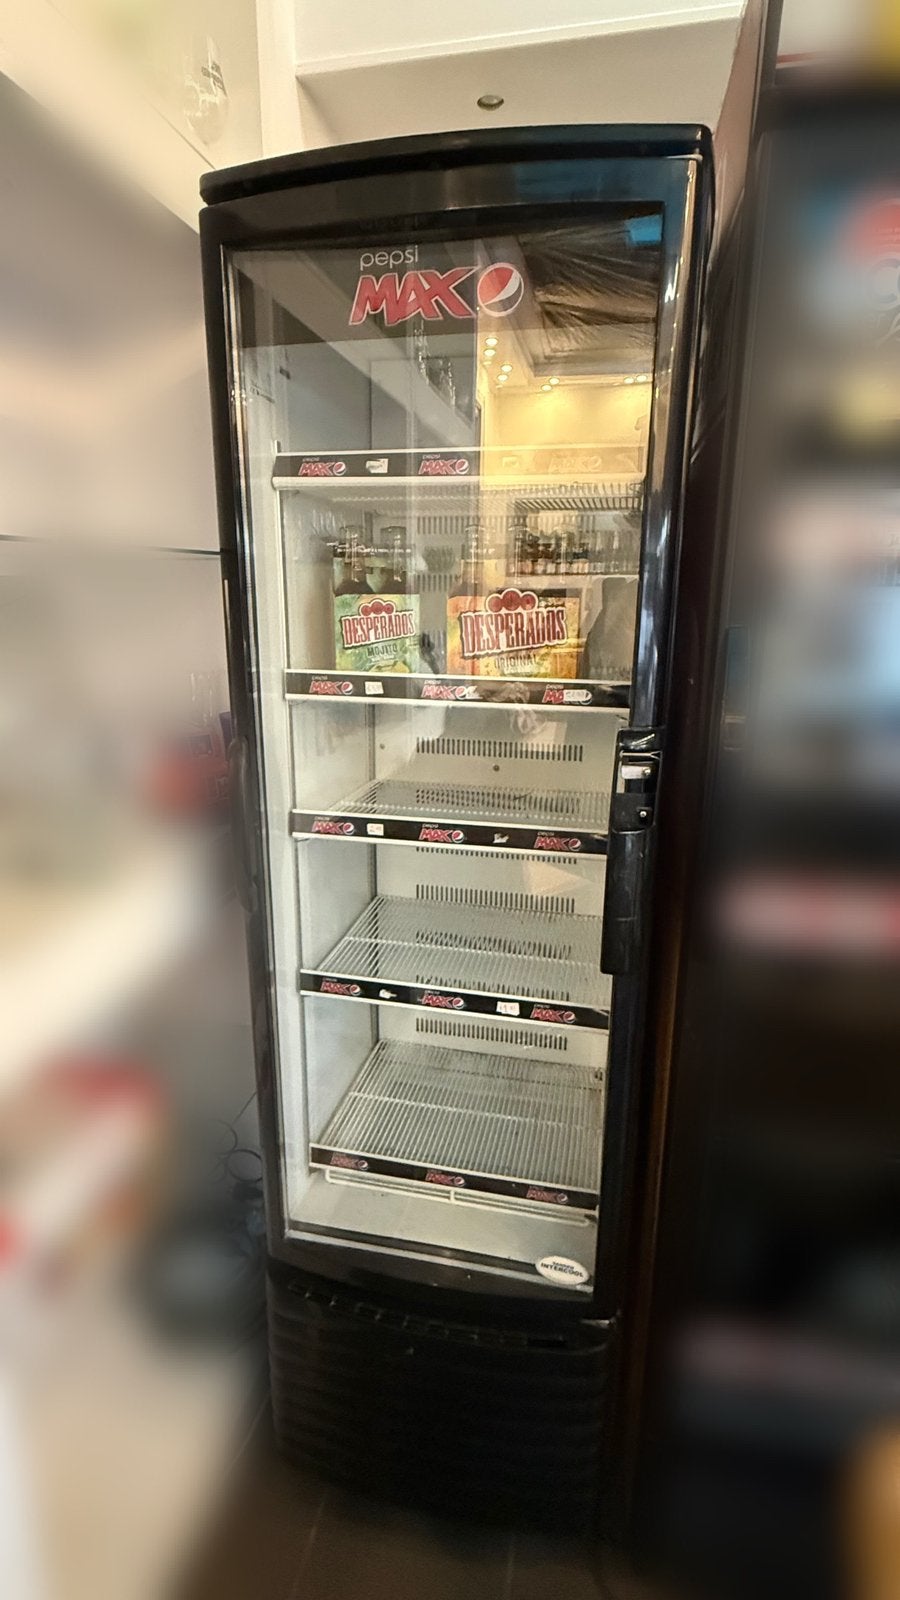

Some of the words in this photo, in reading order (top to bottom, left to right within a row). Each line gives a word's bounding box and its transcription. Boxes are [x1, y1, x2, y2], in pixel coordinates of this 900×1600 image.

[360, 245, 419, 271] pepsi
[349, 265, 481, 326] MAX
[298, 461, 335, 476] MAX
[418, 459, 457, 475] MAX
[343, 612, 415, 646] DESPERADOS
[462, 609, 566, 654] DESPERADOS
[367, 643, 398, 656] MOJITO
[495, 654, 538, 669] ORIGINAL
[309, 681, 342, 695] MAX
[421, 685, 457, 700] MAX
[311, 821, 344, 835] MAX
[419, 828, 453, 842] MAX
[534, 836, 570, 850] MAX
[421, 994, 454, 1008] MAX
[530, 1008, 565, 1022] MAX
